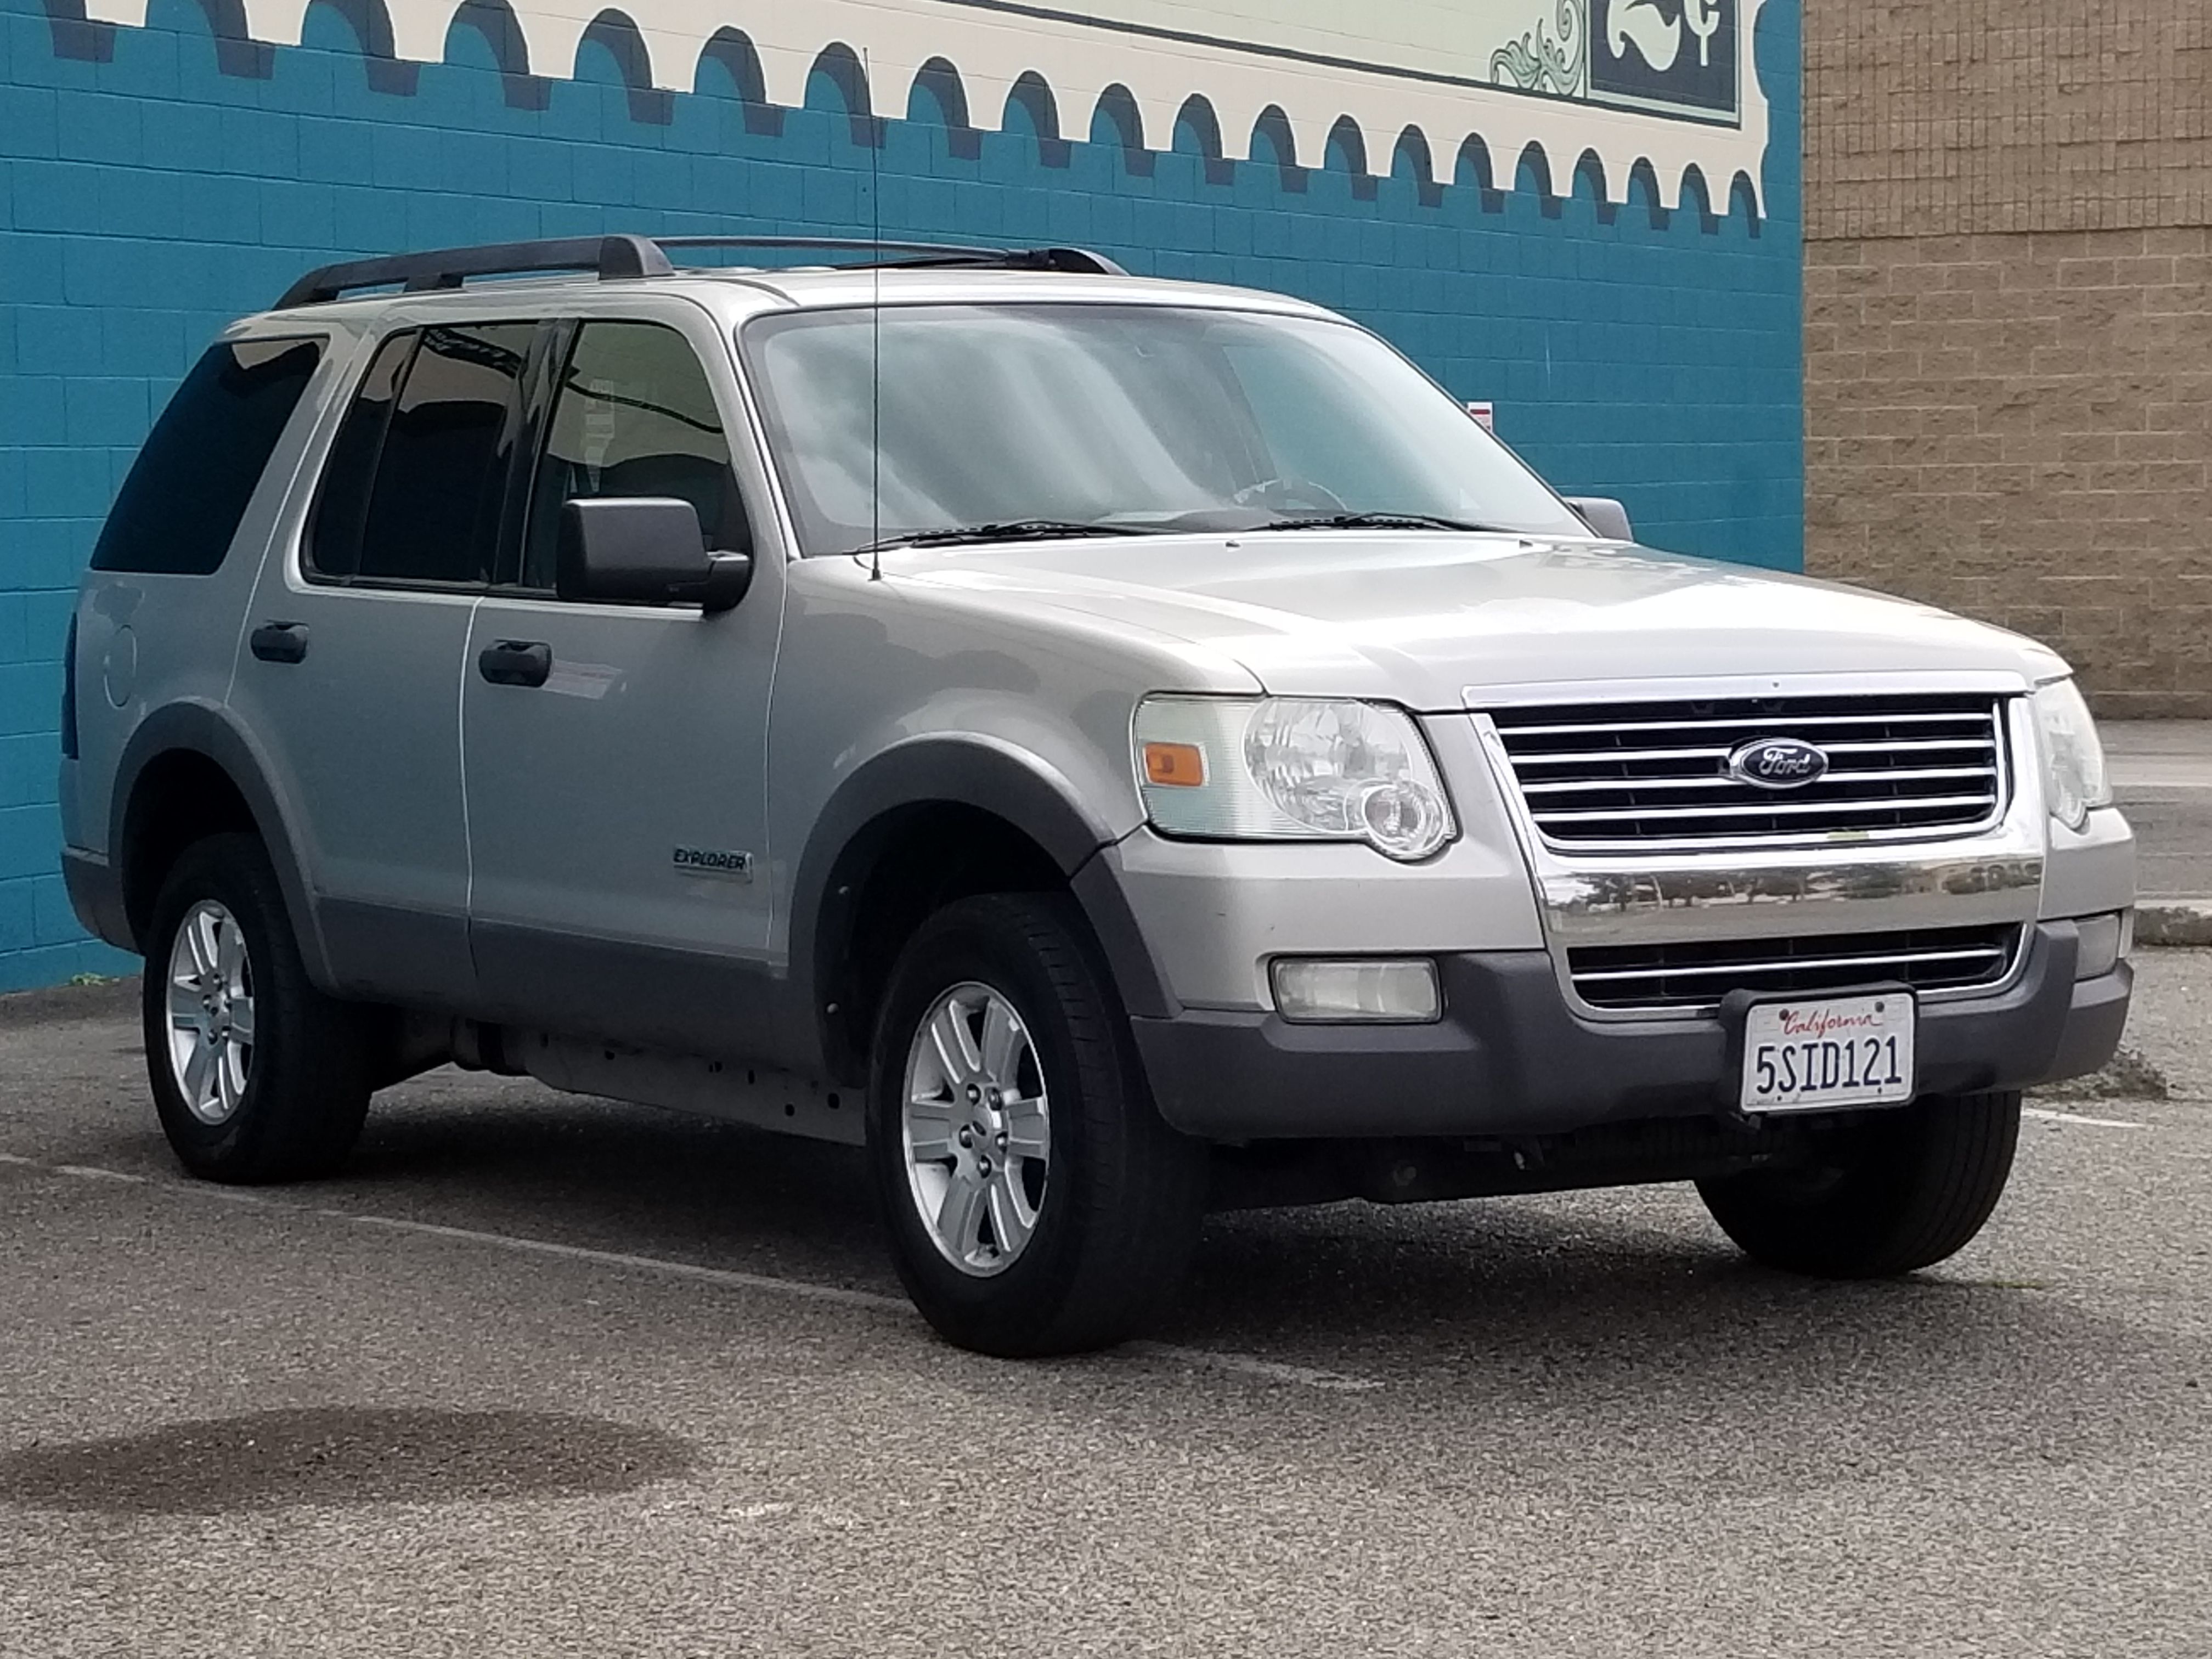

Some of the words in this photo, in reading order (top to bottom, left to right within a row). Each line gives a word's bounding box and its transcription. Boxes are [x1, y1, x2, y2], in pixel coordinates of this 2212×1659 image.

[1759, 747, 1810, 775] Ford
[674, 849, 746, 870] EXPLORER
[1784, 1009, 1883, 1039] California
[1757, 1036, 1901, 1093] 5SID121
